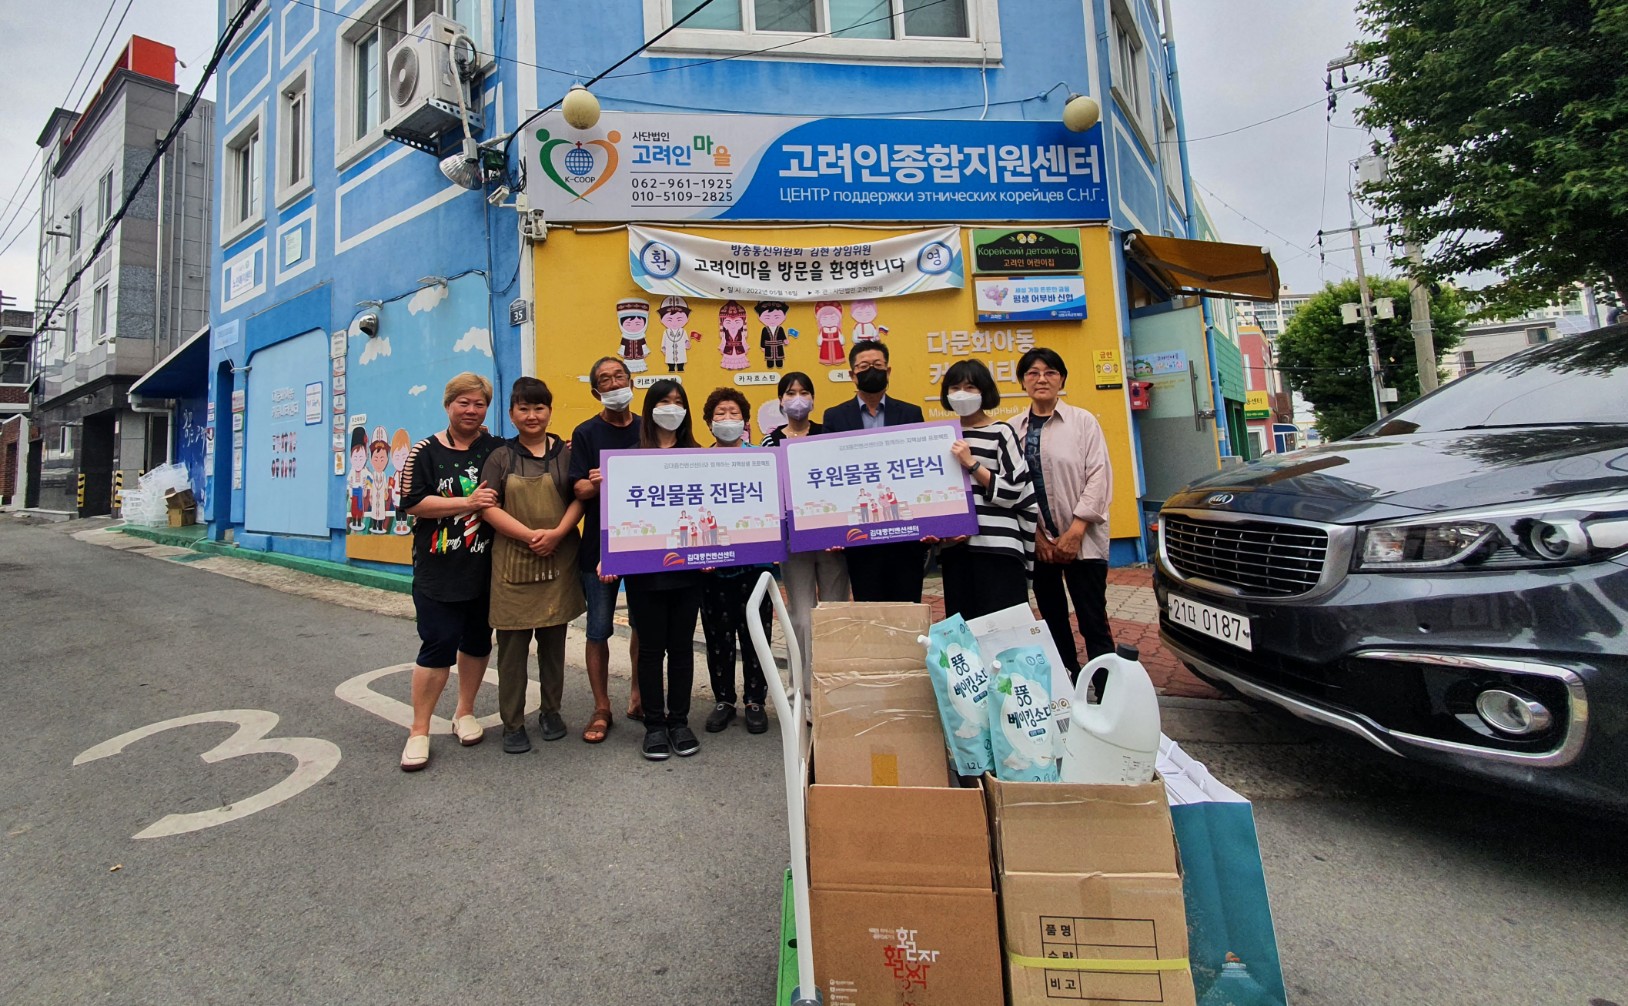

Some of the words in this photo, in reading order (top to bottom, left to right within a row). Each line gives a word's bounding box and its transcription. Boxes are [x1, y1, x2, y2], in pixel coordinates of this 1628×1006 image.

[632, 131, 670, 142] 사단법인
[779, 143, 1100, 184] 고려인종합지원센터
[631, 178, 732, 189] 062-961-1925
[631, 191, 733, 202] 010-5109-2825
[780, 188, 830, 202] ЦЕНТР
[833, 190, 914, 205] поддержки
[917, 190, 997, 202] этнических
[1000, 188, 1064, 204] корейцев
[731, 244, 803, 257] 방송통신위원회
[810, 247, 829, 257] 김현
[833, 244, 871, 257] 상임위원
[926, 250, 941, 267] 영
[978, 247, 1024, 257] Корейский
[1026, 247, 1060, 256] детский
[1061, 247, 1077, 255] сад
[650, 249, 671, 272] 환
[694, 258, 771, 281] 고려인마을
[777, 259, 824, 281] 방문을
[829, 257, 906, 281] 환영합니다
[1026, 258, 1055, 267] 어린이집
[513, 310, 523, 321] 35
[927, 328, 1035, 356] 다문화아동
[807, 461, 882, 490] 후원물품
[886, 454, 945, 481] 전달식
[626, 483, 705, 508] 후원물품
[709, 480, 763, 505] 전달식
[1030, 626, 1041, 635] 85
[1202, 608, 1241, 641] 0187
